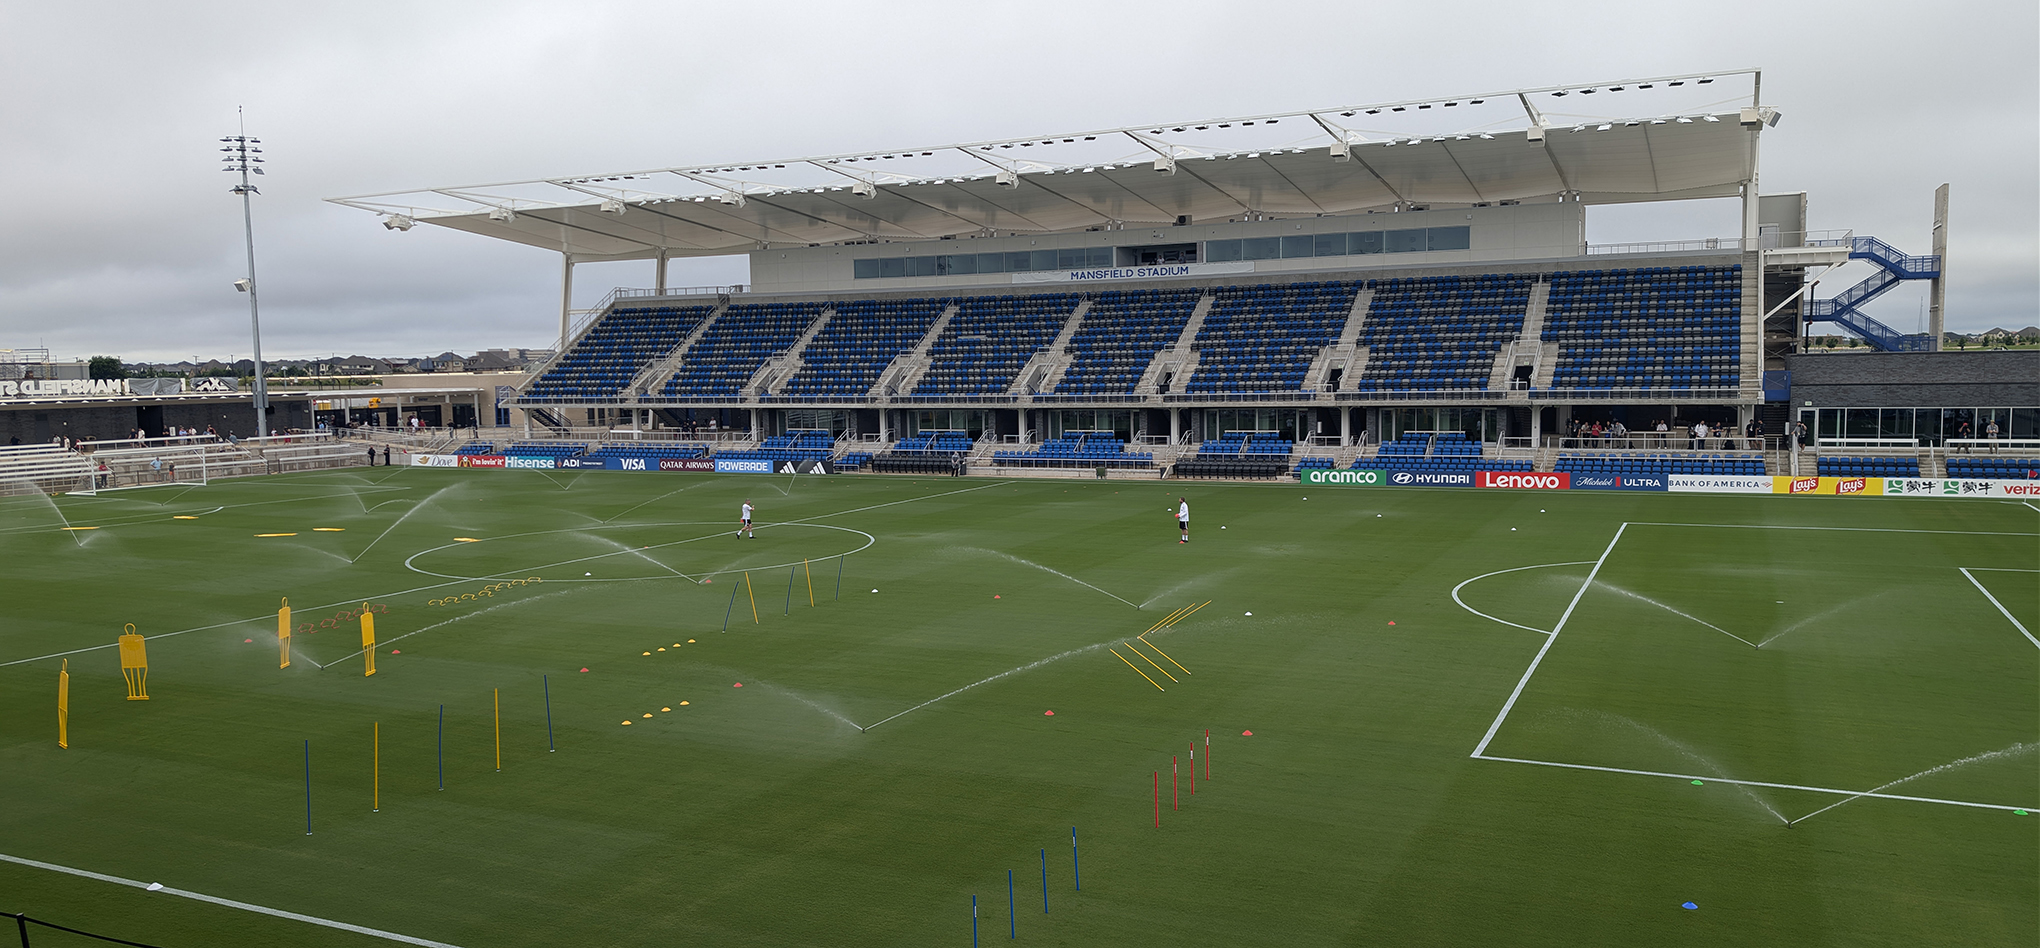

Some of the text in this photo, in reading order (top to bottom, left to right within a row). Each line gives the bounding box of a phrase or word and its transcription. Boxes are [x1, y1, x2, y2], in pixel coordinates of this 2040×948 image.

[1070, 266, 1189, 280] MANSFIELD STADIUM
[431, 455, 453, 466] Dove
[505, 456, 555, 468] Hisense
[562, 458, 580, 467] ADI
[620, 458, 646, 470] VISA
[660, 460, 715, 470] QATAR AIRWAYS
[718, 461, 768, 471] POWERADE
[1309, 471, 1377, 484] aramco
[1416, 474, 1470, 484] HYUNDAI
[1485, 472, 1560, 489] Lenovo
[1575, 476, 1661, 487] Michelob ULTRA
[1713, 480, 1760, 488] AMERICA
[1793, 477, 1817, 492] Lay's
[1839, 478, 1864, 493] Lay's
[1906, 480, 1936, 494] 蒙牛
[1962, 481, 1994, 495] 蒙牛
